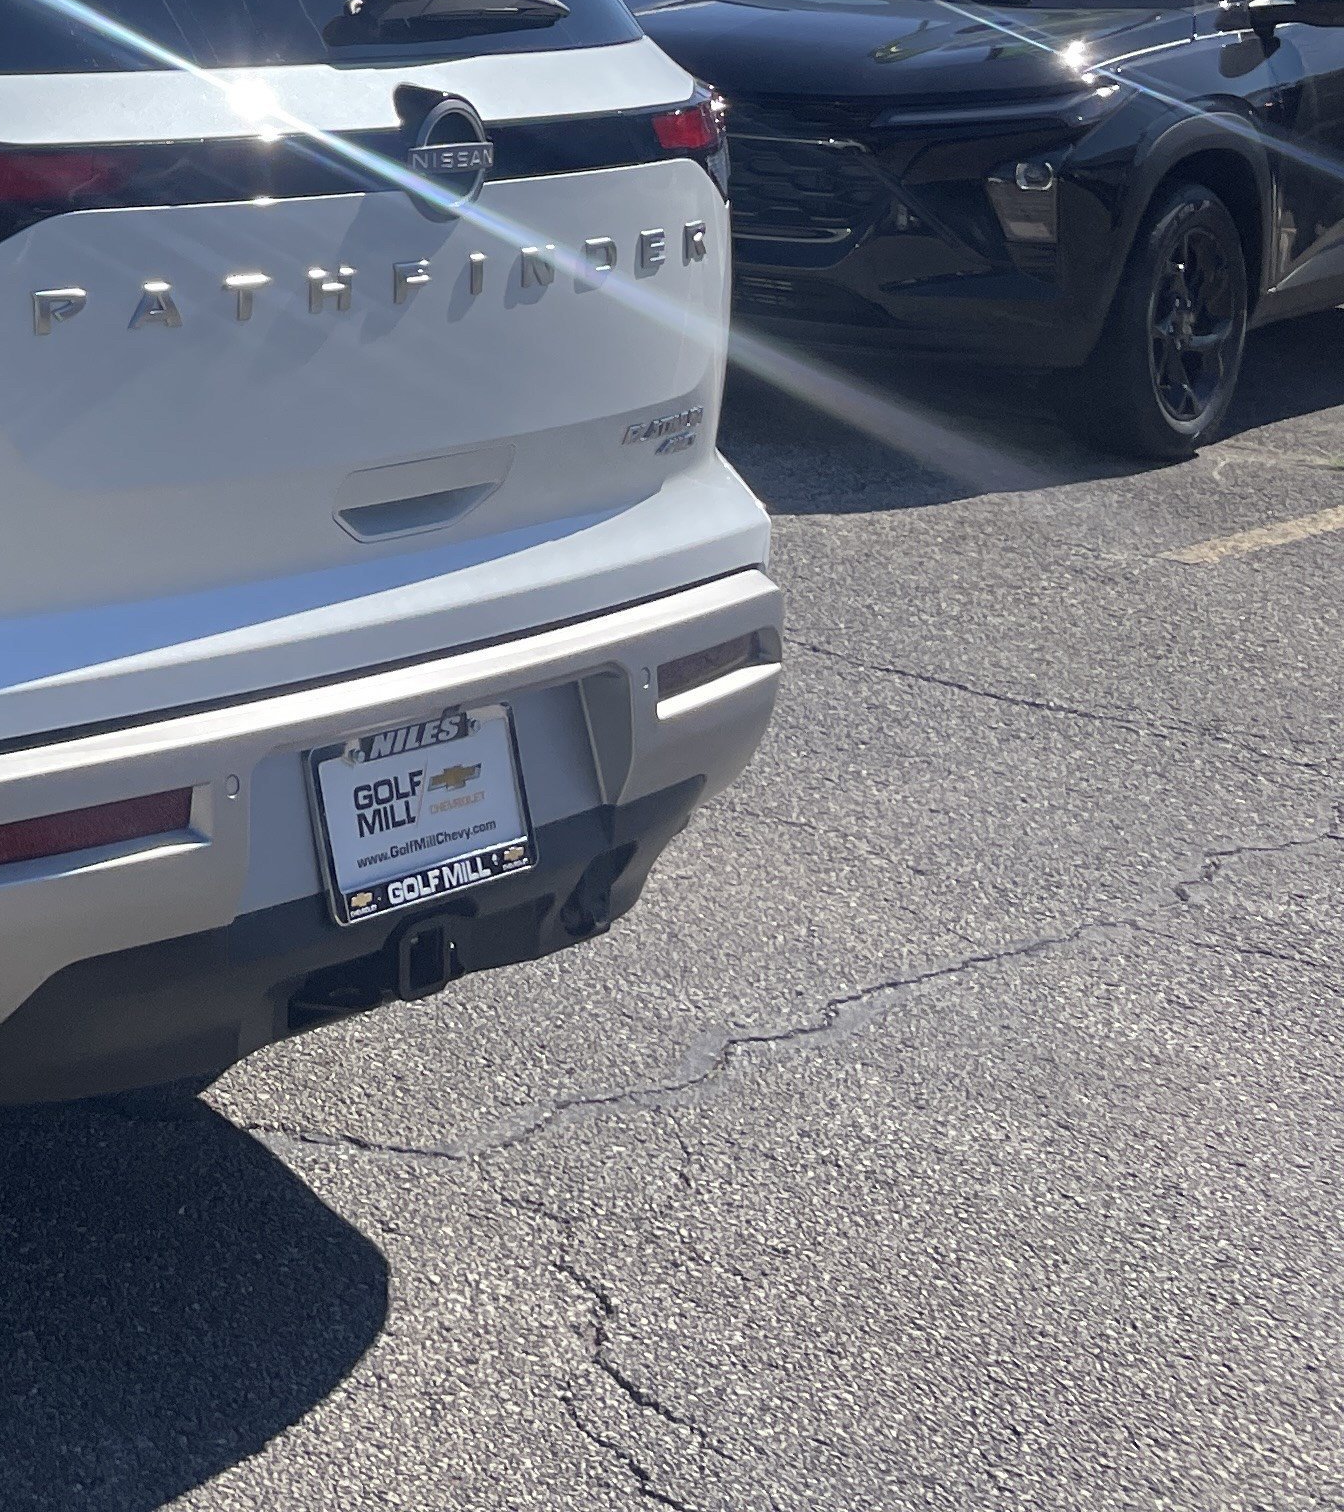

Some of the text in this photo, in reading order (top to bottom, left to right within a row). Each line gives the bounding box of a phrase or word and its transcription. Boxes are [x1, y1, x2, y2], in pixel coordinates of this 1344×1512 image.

[411, 148, 493, 169] NISSAN
[32, 220, 708, 336] PATHFINDER
[369, 714, 462, 759] NILES
[353, 769, 423, 810] GOLF
[356, 800, 417, 838] MILL
[356, 819, 497, 869] www.GolfMillChevy.com
[387, 856, 492, 906] GOLF MILL
